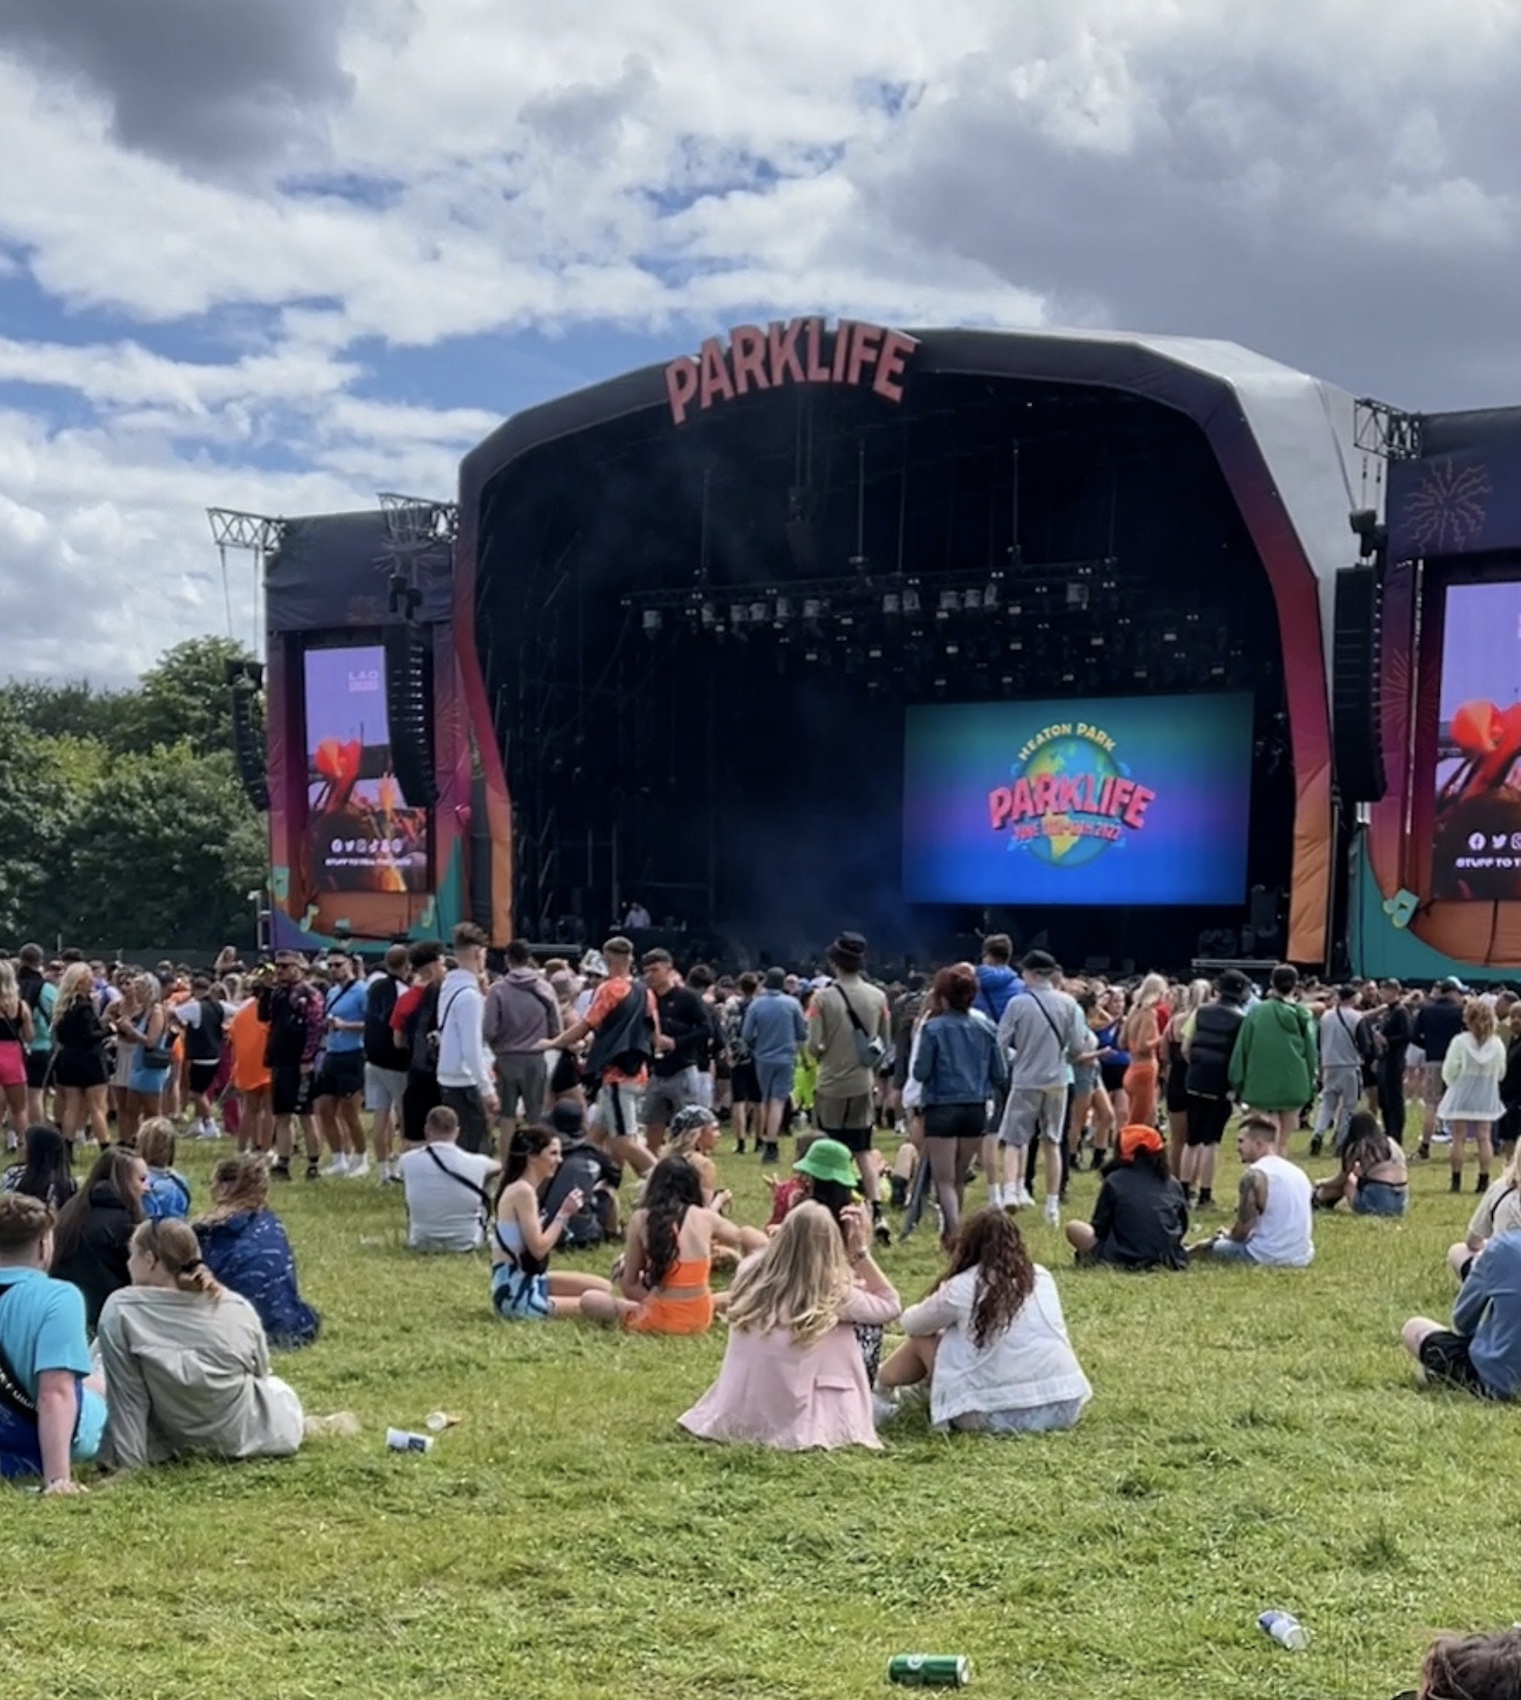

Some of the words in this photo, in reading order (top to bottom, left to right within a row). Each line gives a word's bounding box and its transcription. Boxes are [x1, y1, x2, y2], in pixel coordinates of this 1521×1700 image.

[665, 315, 918, 425] PARKLIFE
[1018, 723, 1072, 761] HEATON
[1077, 722, 1116, 751] PARK
[988, 772, 1156, 830] PARKLIFE
[1496, 857, 1513, 868] TO
